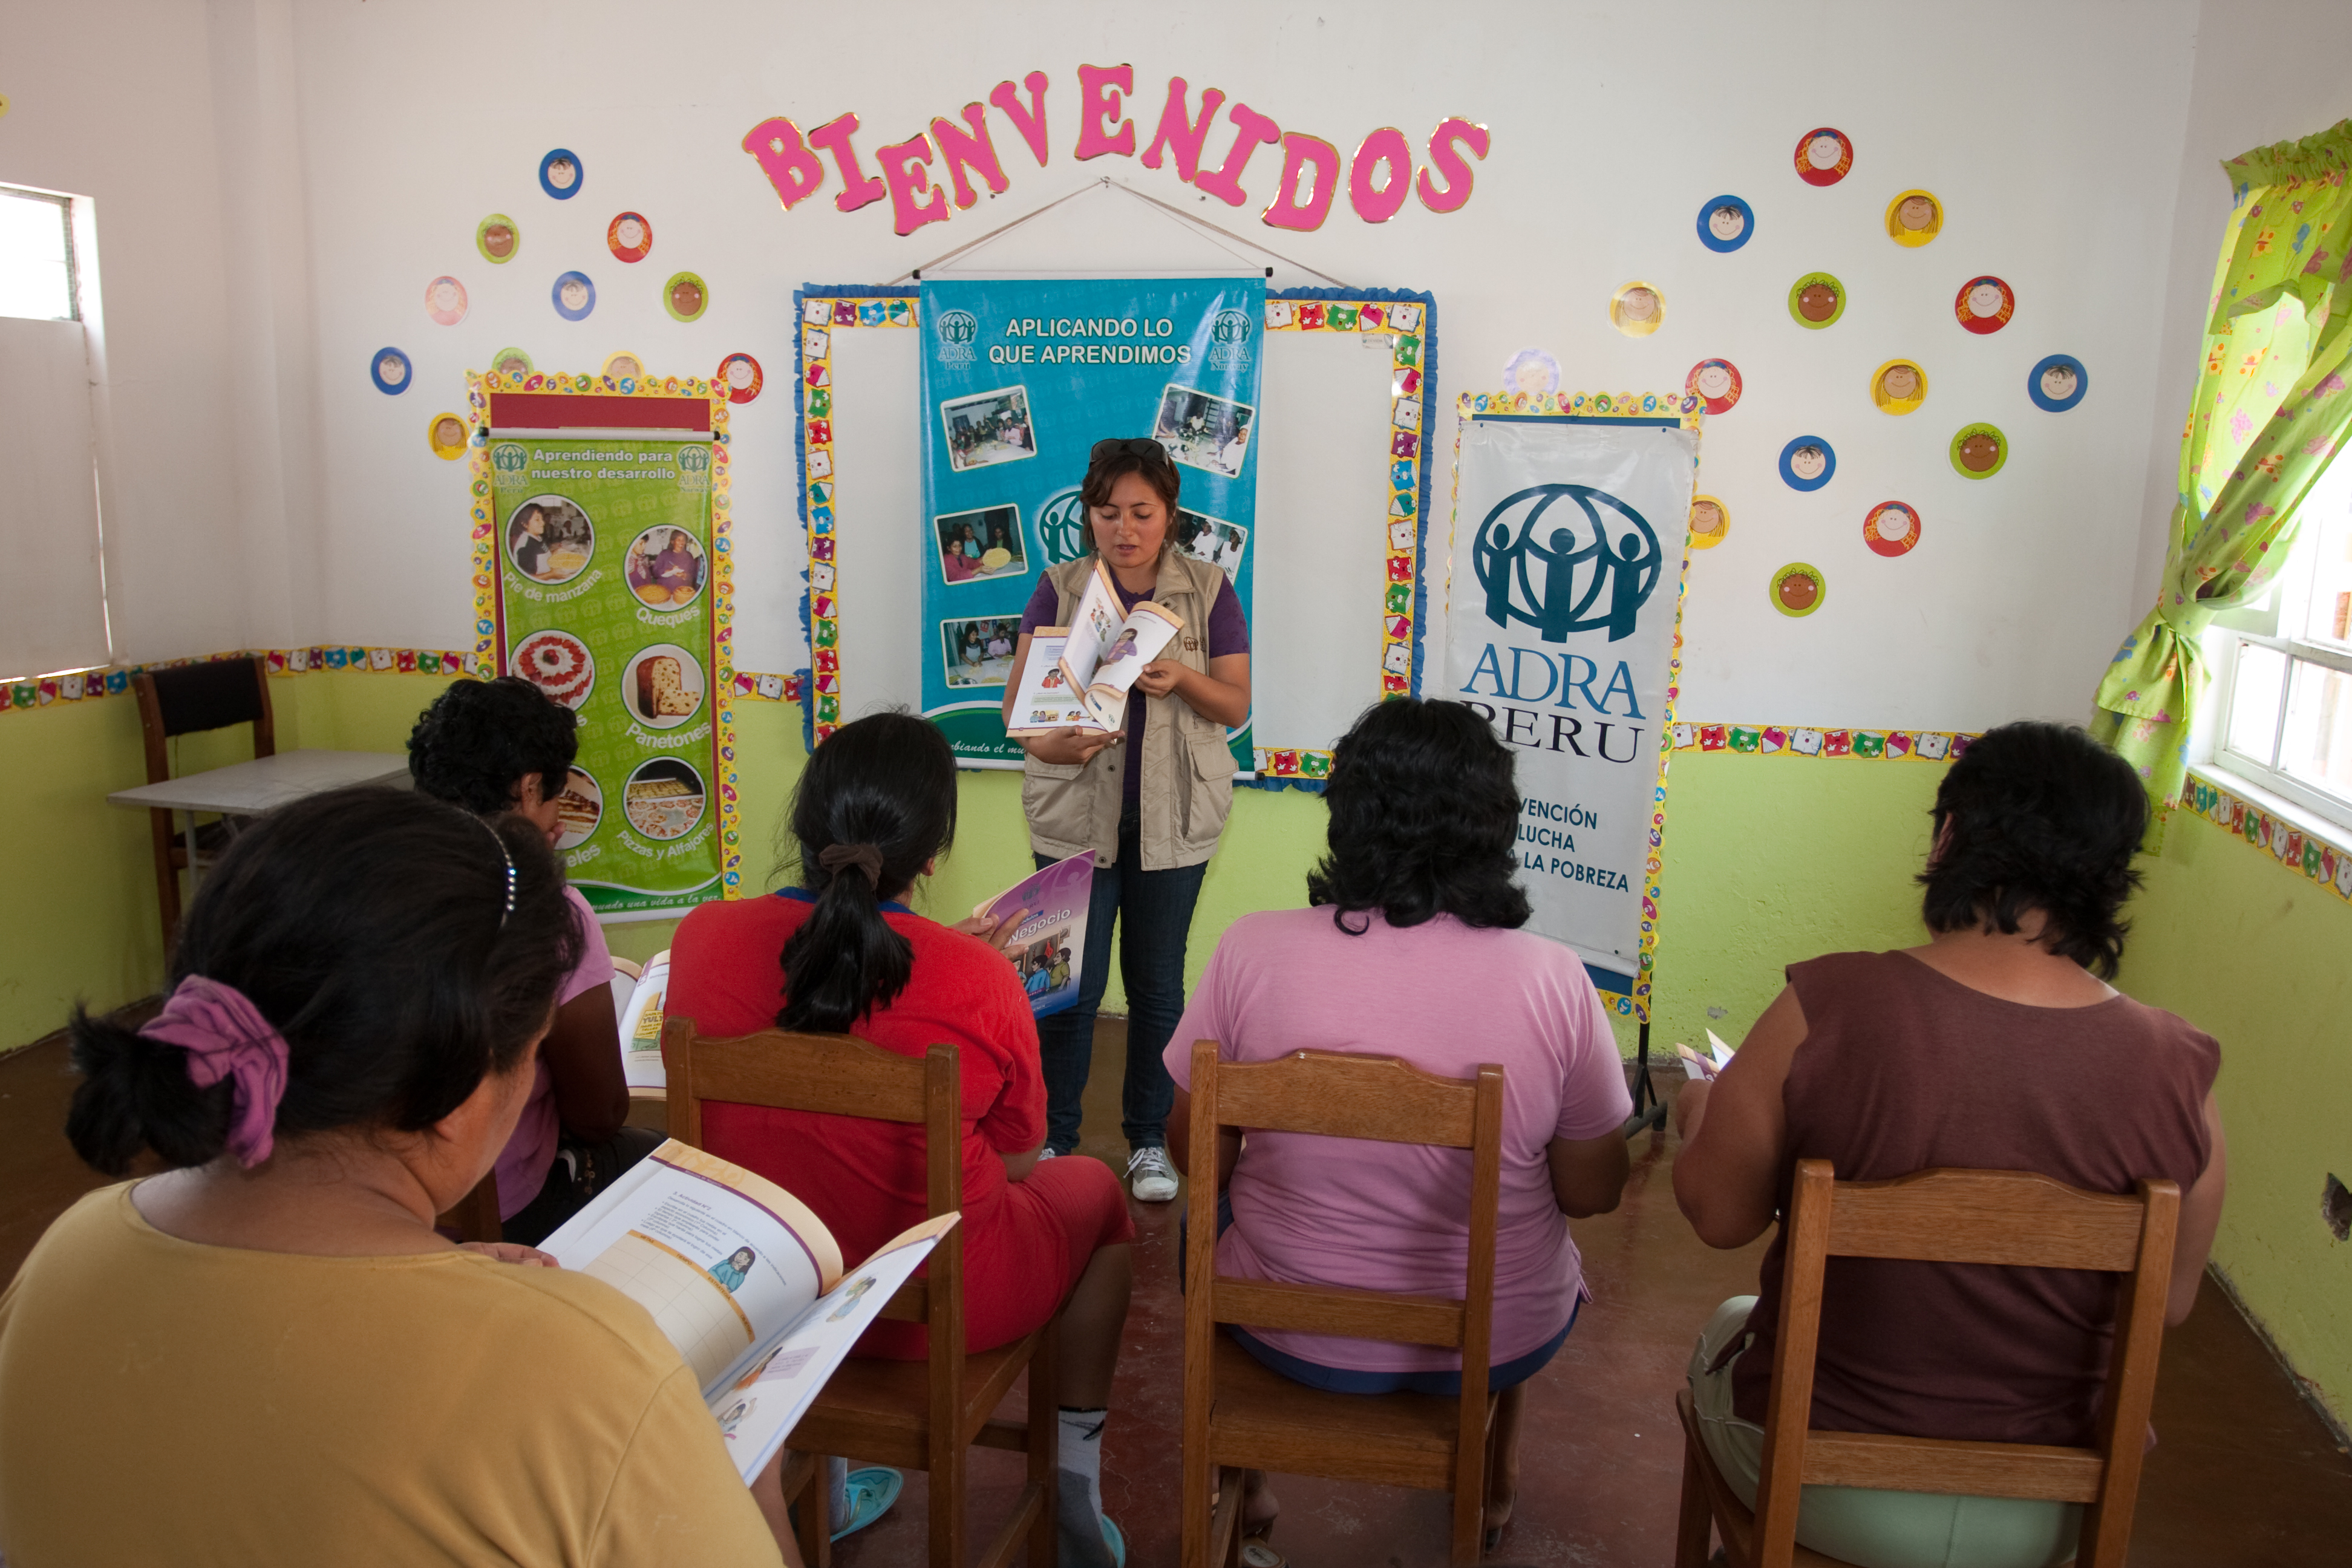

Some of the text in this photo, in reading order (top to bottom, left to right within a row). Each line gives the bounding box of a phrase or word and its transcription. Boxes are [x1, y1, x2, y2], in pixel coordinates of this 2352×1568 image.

[741, 63, 1491, 236] BIENVENIDOS
[1005, 318, 1173, 338] APLICANDO LO
[939, 347, 976, 361] ADRA
[988, 345, 1191, 365] QUE APRENDIMOS
[1211, 347, 1250, 361] ADRA
[1211, 363, 1248, 372] Norway
[533, 449, 672, 463] Aprendiendo para
[494, 475, 528, 485] ADRA
[531, 467, 675, 480] nuestro desarrollo
[678, 475, 710, 485] ADRA
[503, 569, 602, 603] Pie de manzana
[636, 606, 701, 628] Queques
[1459, 643, 1646, 720] ADRA
[625, 722, 711, 750] Panetones
[993, 743, 1005, 753] el
[616, 822, 714, 861] Pizzas y Alfajores
[1518, 823, 1575, 852] LUCHA
[1524, 852, 1544, 872] LA
[1551, 857, 1628, 893] POBREZA
[650, 897, 674, 906] vida
[687, 894, 699, 904] la
[1009, 909, 1071, 945] Negocio
